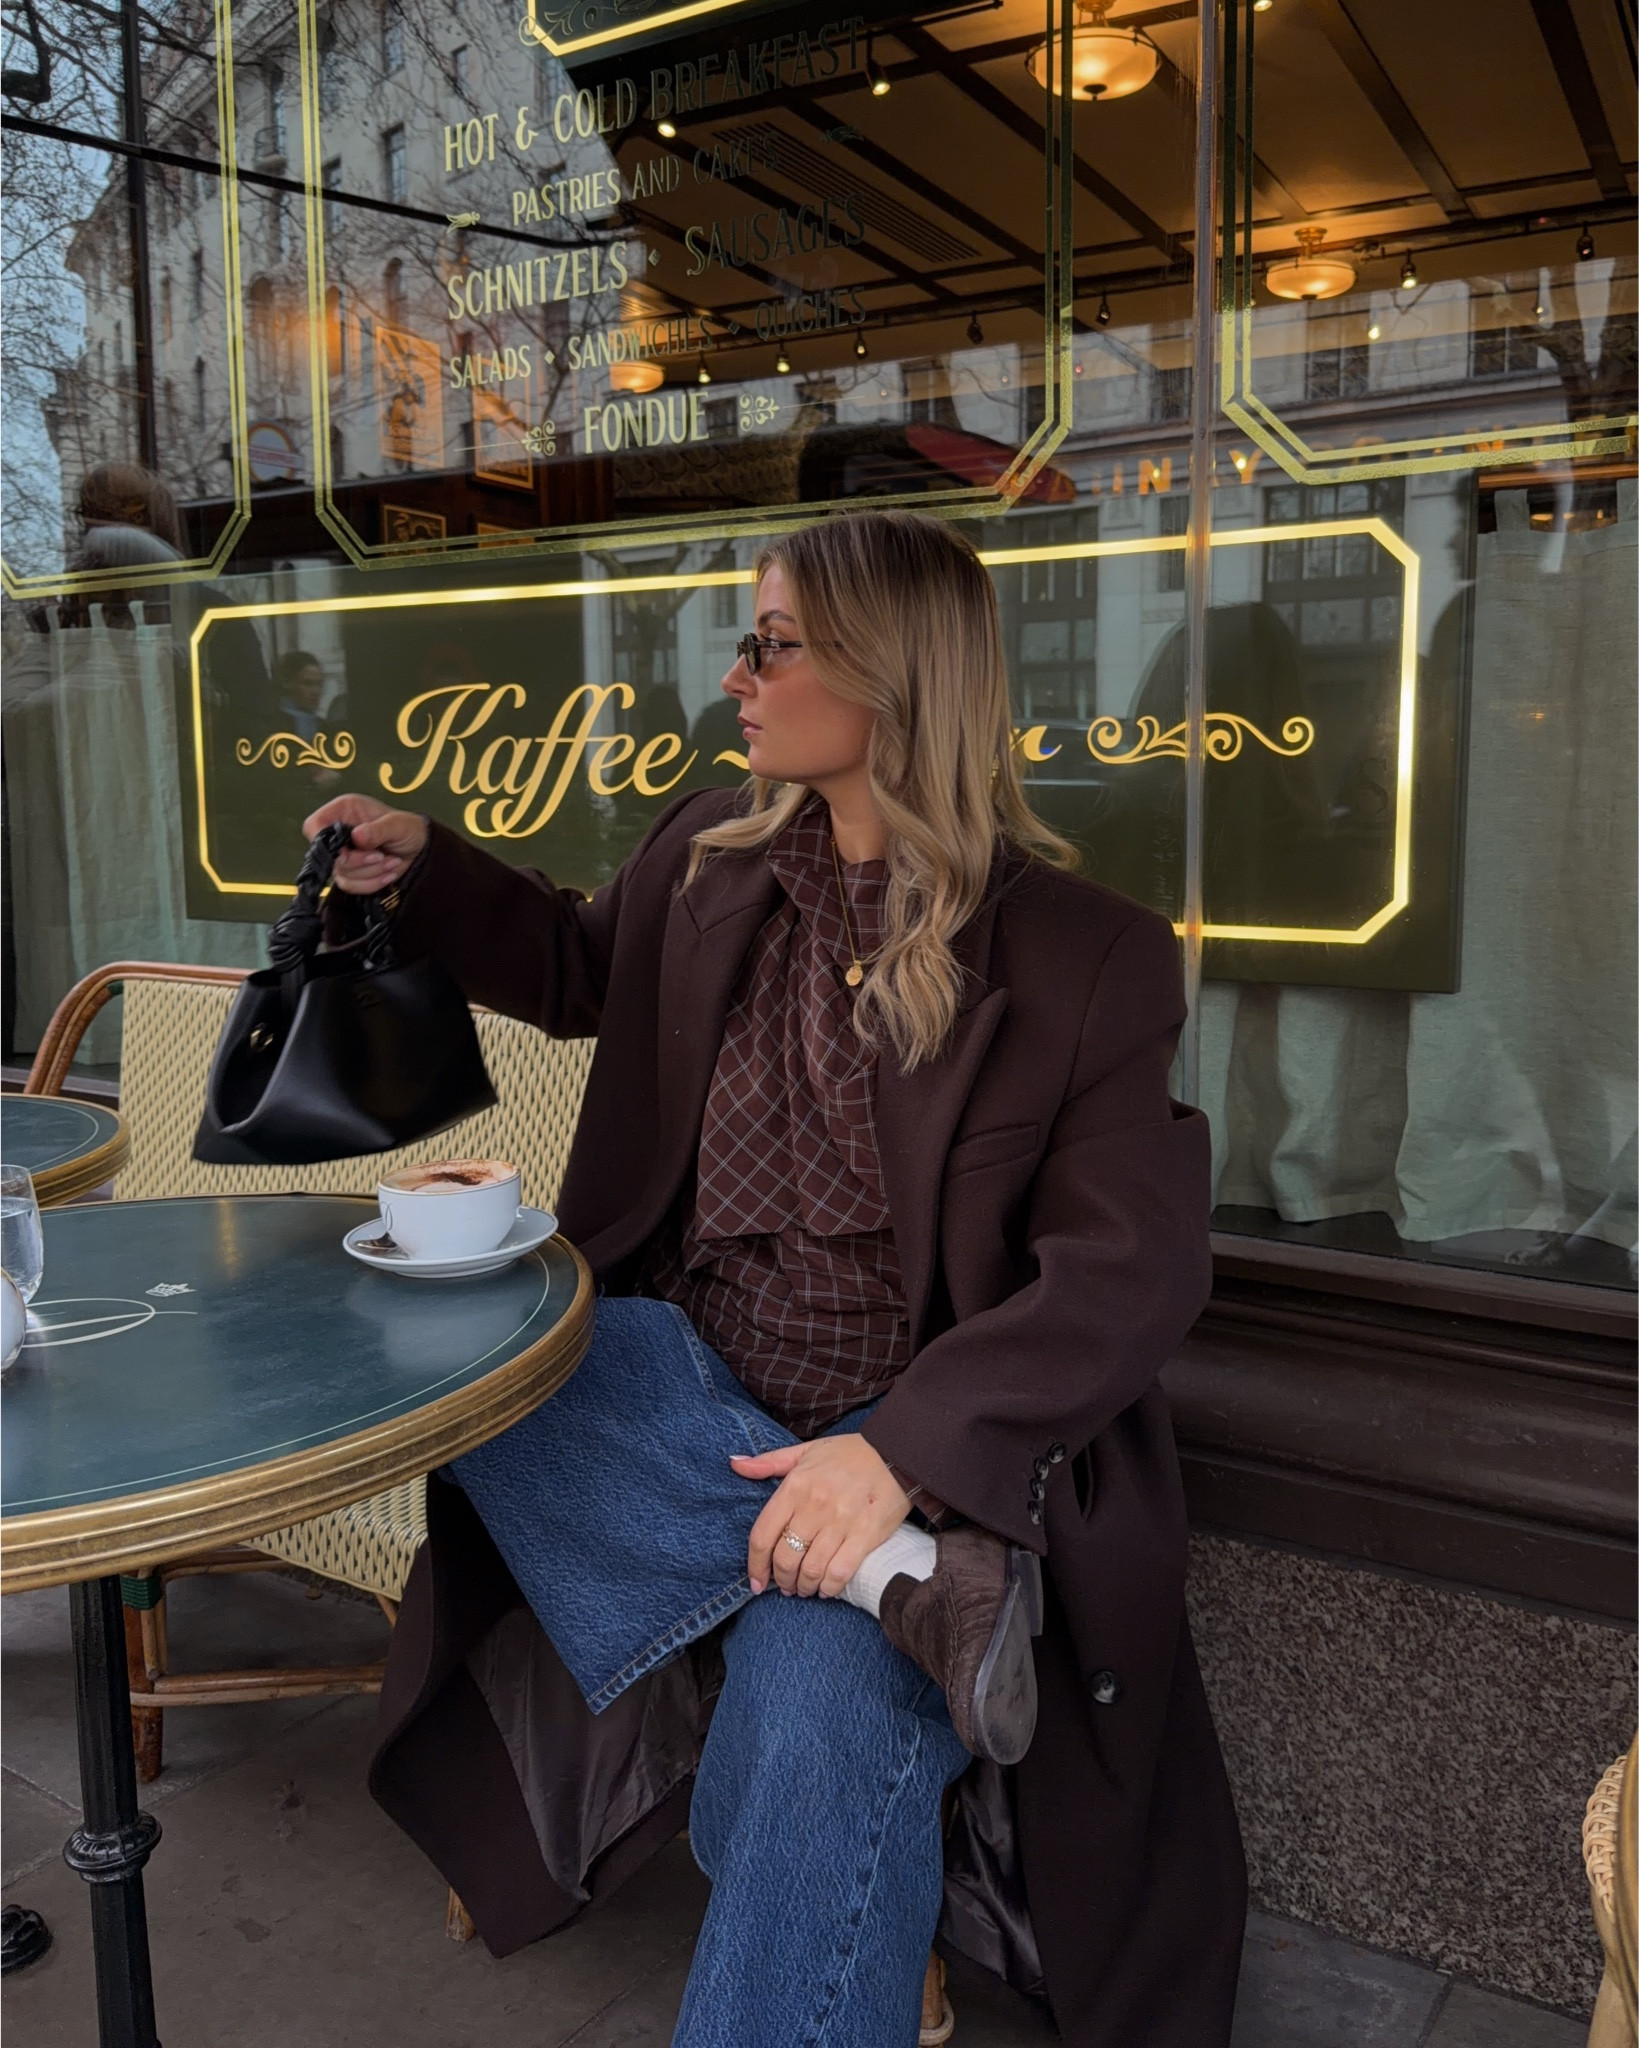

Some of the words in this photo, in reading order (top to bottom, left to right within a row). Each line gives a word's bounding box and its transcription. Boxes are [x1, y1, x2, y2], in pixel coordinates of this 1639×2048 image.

[444, 114, 500, 171] HOT
[515, 106, 537, 151] &
[554, 79, 637, 143] COLD
[650, 17, 865, 121] BREAKFAST
[513, 169, 622, 226] PASTRIES
[632, 155, 681, 200] AND
[694, 133, 779, 184] CAKES
[448, 243, 628, 320] SCHNITZELS
[686, 194, 866, 277] SAUSAGES
[450, 346, 532, 389] SALADS
[569, 315, 713, 370] SANDWICHES
[756, 288, 867, 341] QUICHES
[585, 393, 710, 454] FONDUE
[379, 683, 699, 838] Kaffee
